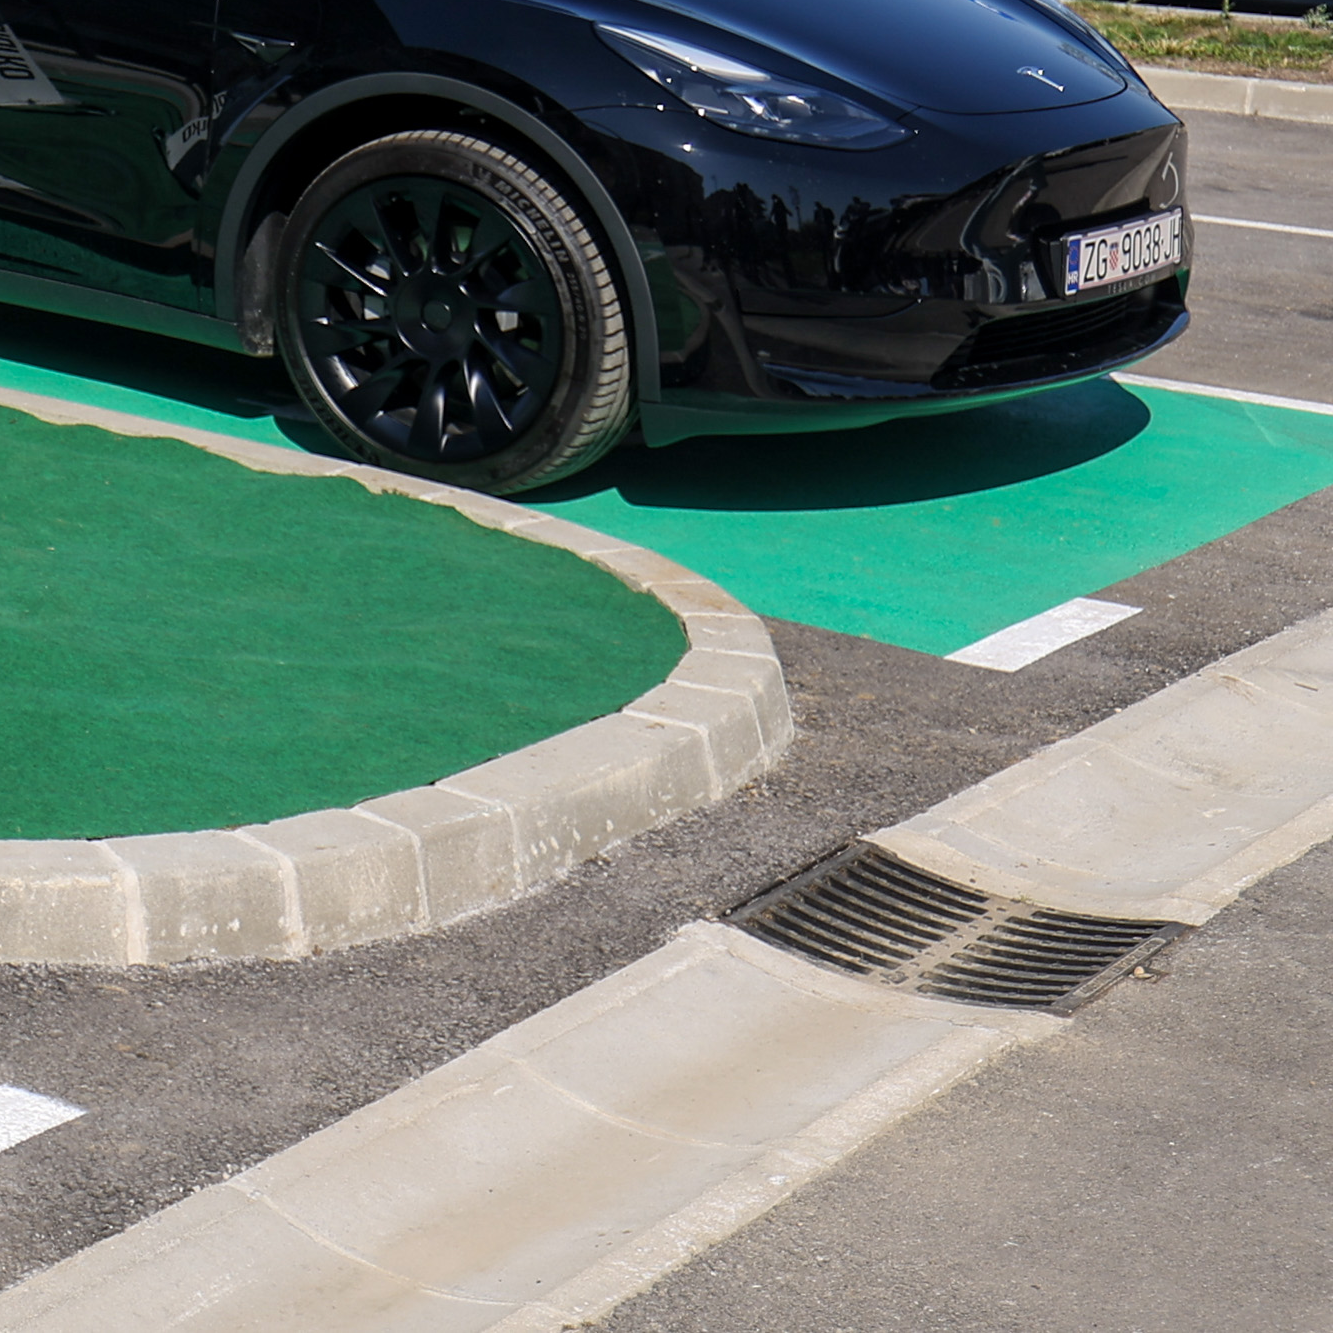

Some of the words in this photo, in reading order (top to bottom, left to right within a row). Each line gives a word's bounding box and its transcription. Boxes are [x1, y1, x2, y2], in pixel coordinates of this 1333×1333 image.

[494, 181, 570, 263] MICHELIN
[1068, 271, 1078, 285] HR
[1083, 238, 1108, 284] ZG
